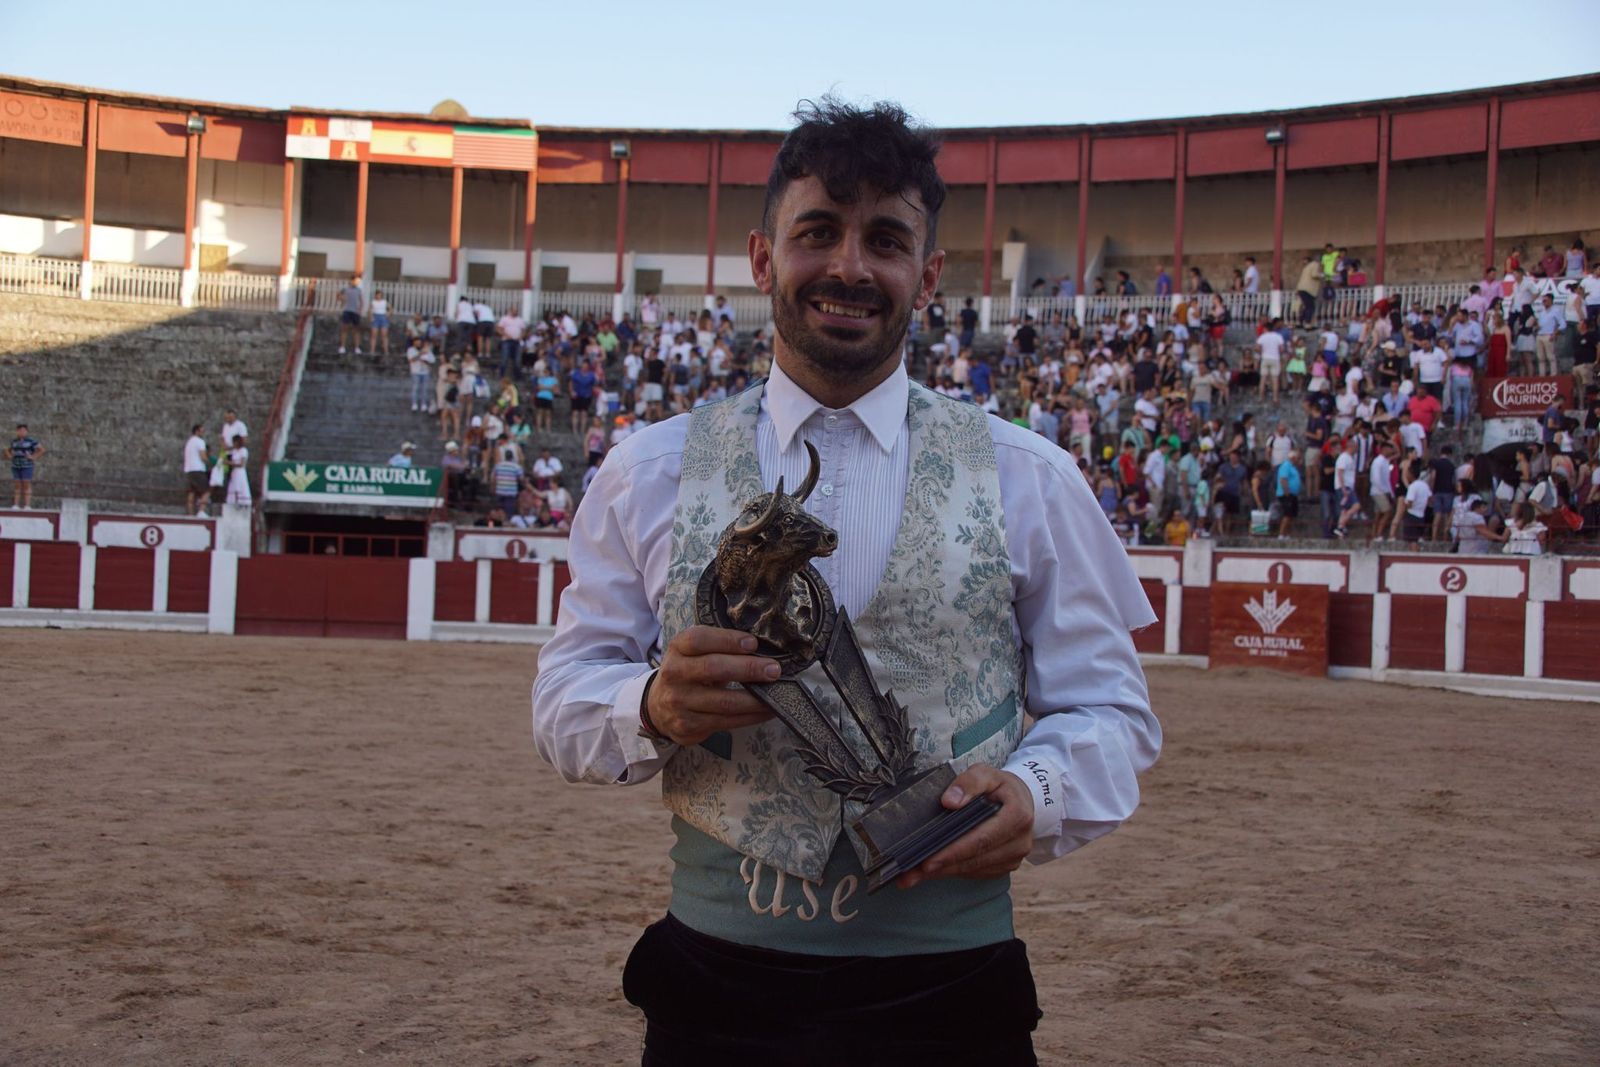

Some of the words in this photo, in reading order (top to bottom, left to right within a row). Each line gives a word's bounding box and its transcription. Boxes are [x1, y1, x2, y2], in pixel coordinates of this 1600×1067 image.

[1493, 379, 1558, 405] CIRCUITOS
[324, 465, 368, 482] CAJA
[369, 467, 432, 485] RURAL
[145, 526, 159, 545] 8
[1446, 569, 1461, 591] 2
[1263, 636, 1305, 650] RURAL
